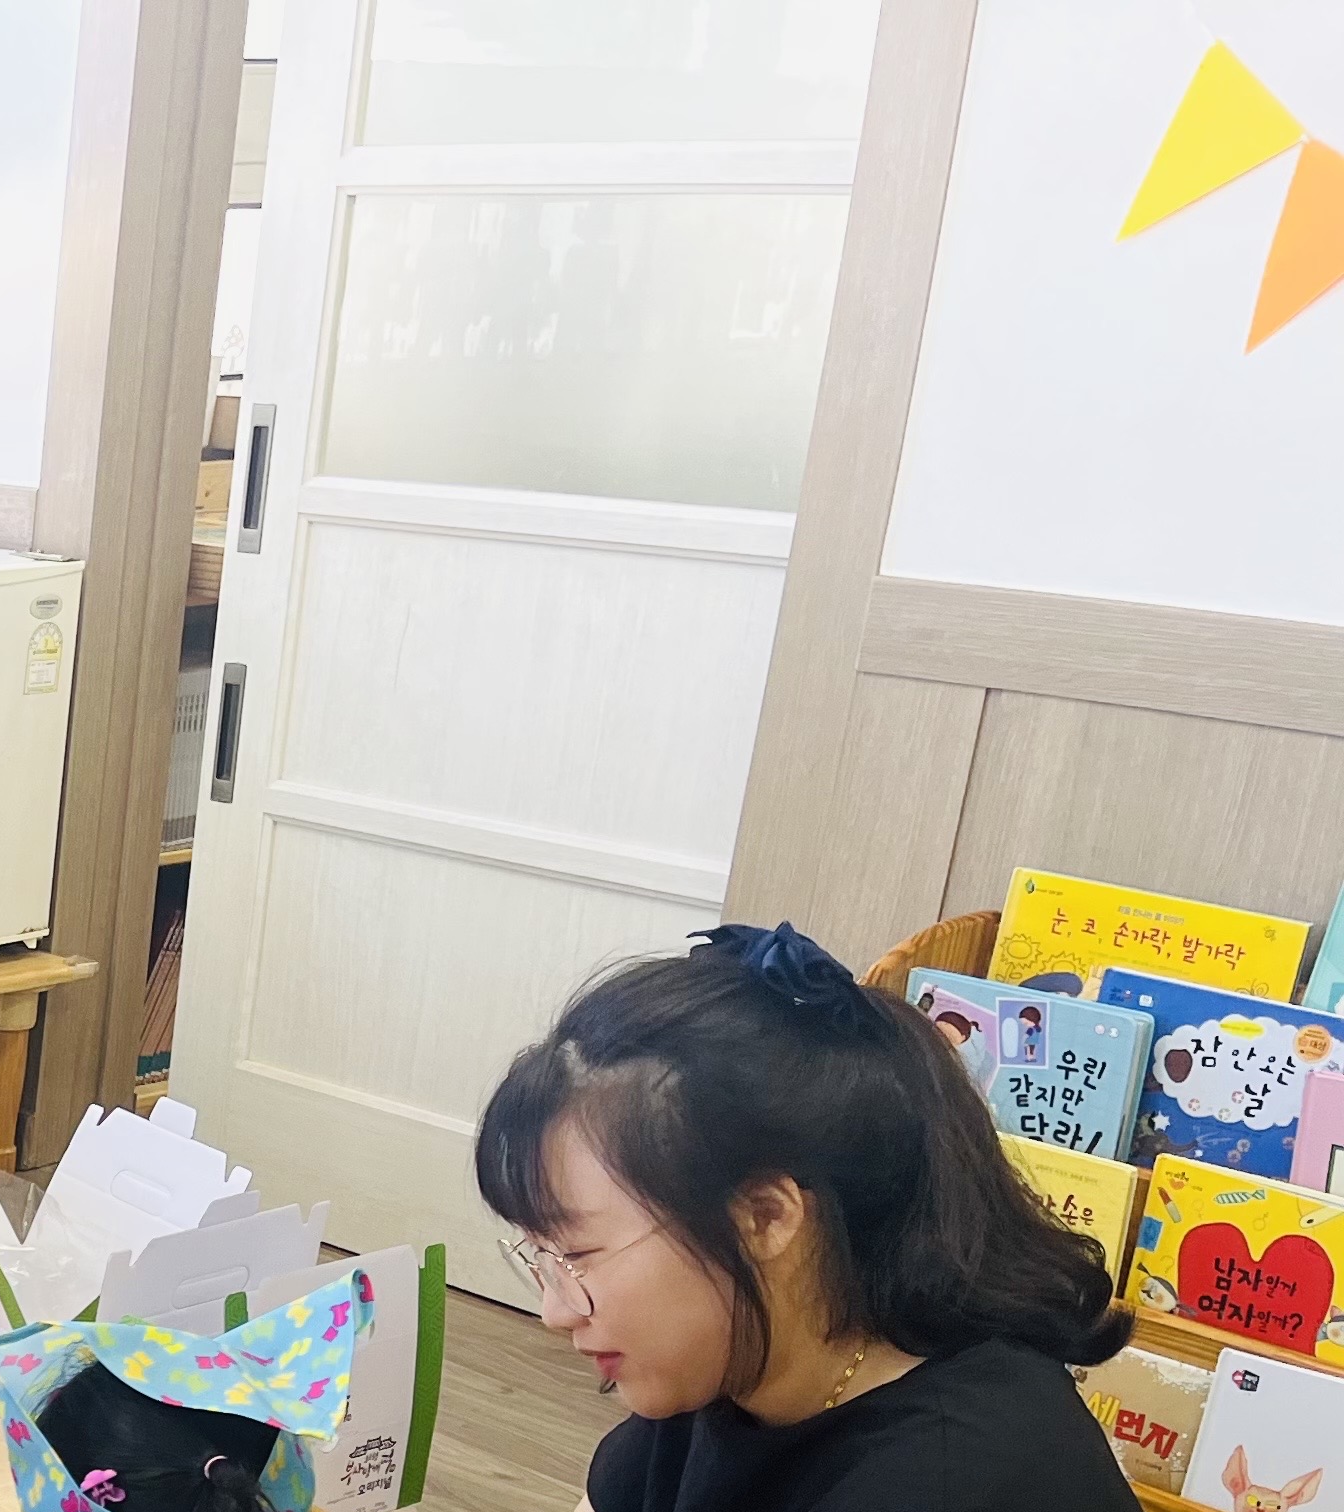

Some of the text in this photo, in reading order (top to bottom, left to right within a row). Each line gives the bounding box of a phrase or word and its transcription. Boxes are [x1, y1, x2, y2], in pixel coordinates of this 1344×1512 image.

[1113, 921, 1172, 960] 손가락,
[1182, 934, 1247, 971] 발가락
[1056, 1050, 1107, 1091] 우린
[1191, 1035, 1298, 1087] 잠 안 오는
[1009, 1073, 1085, 1117] 같지만
[1244, 1082, 1272, 1119] 날
[1213, 1256, 1298, 1299] 남자일까
[1197, 1293, 1304, 1339] 여자일까?
[1085, 1390, 1180, 1461] 세먼지
